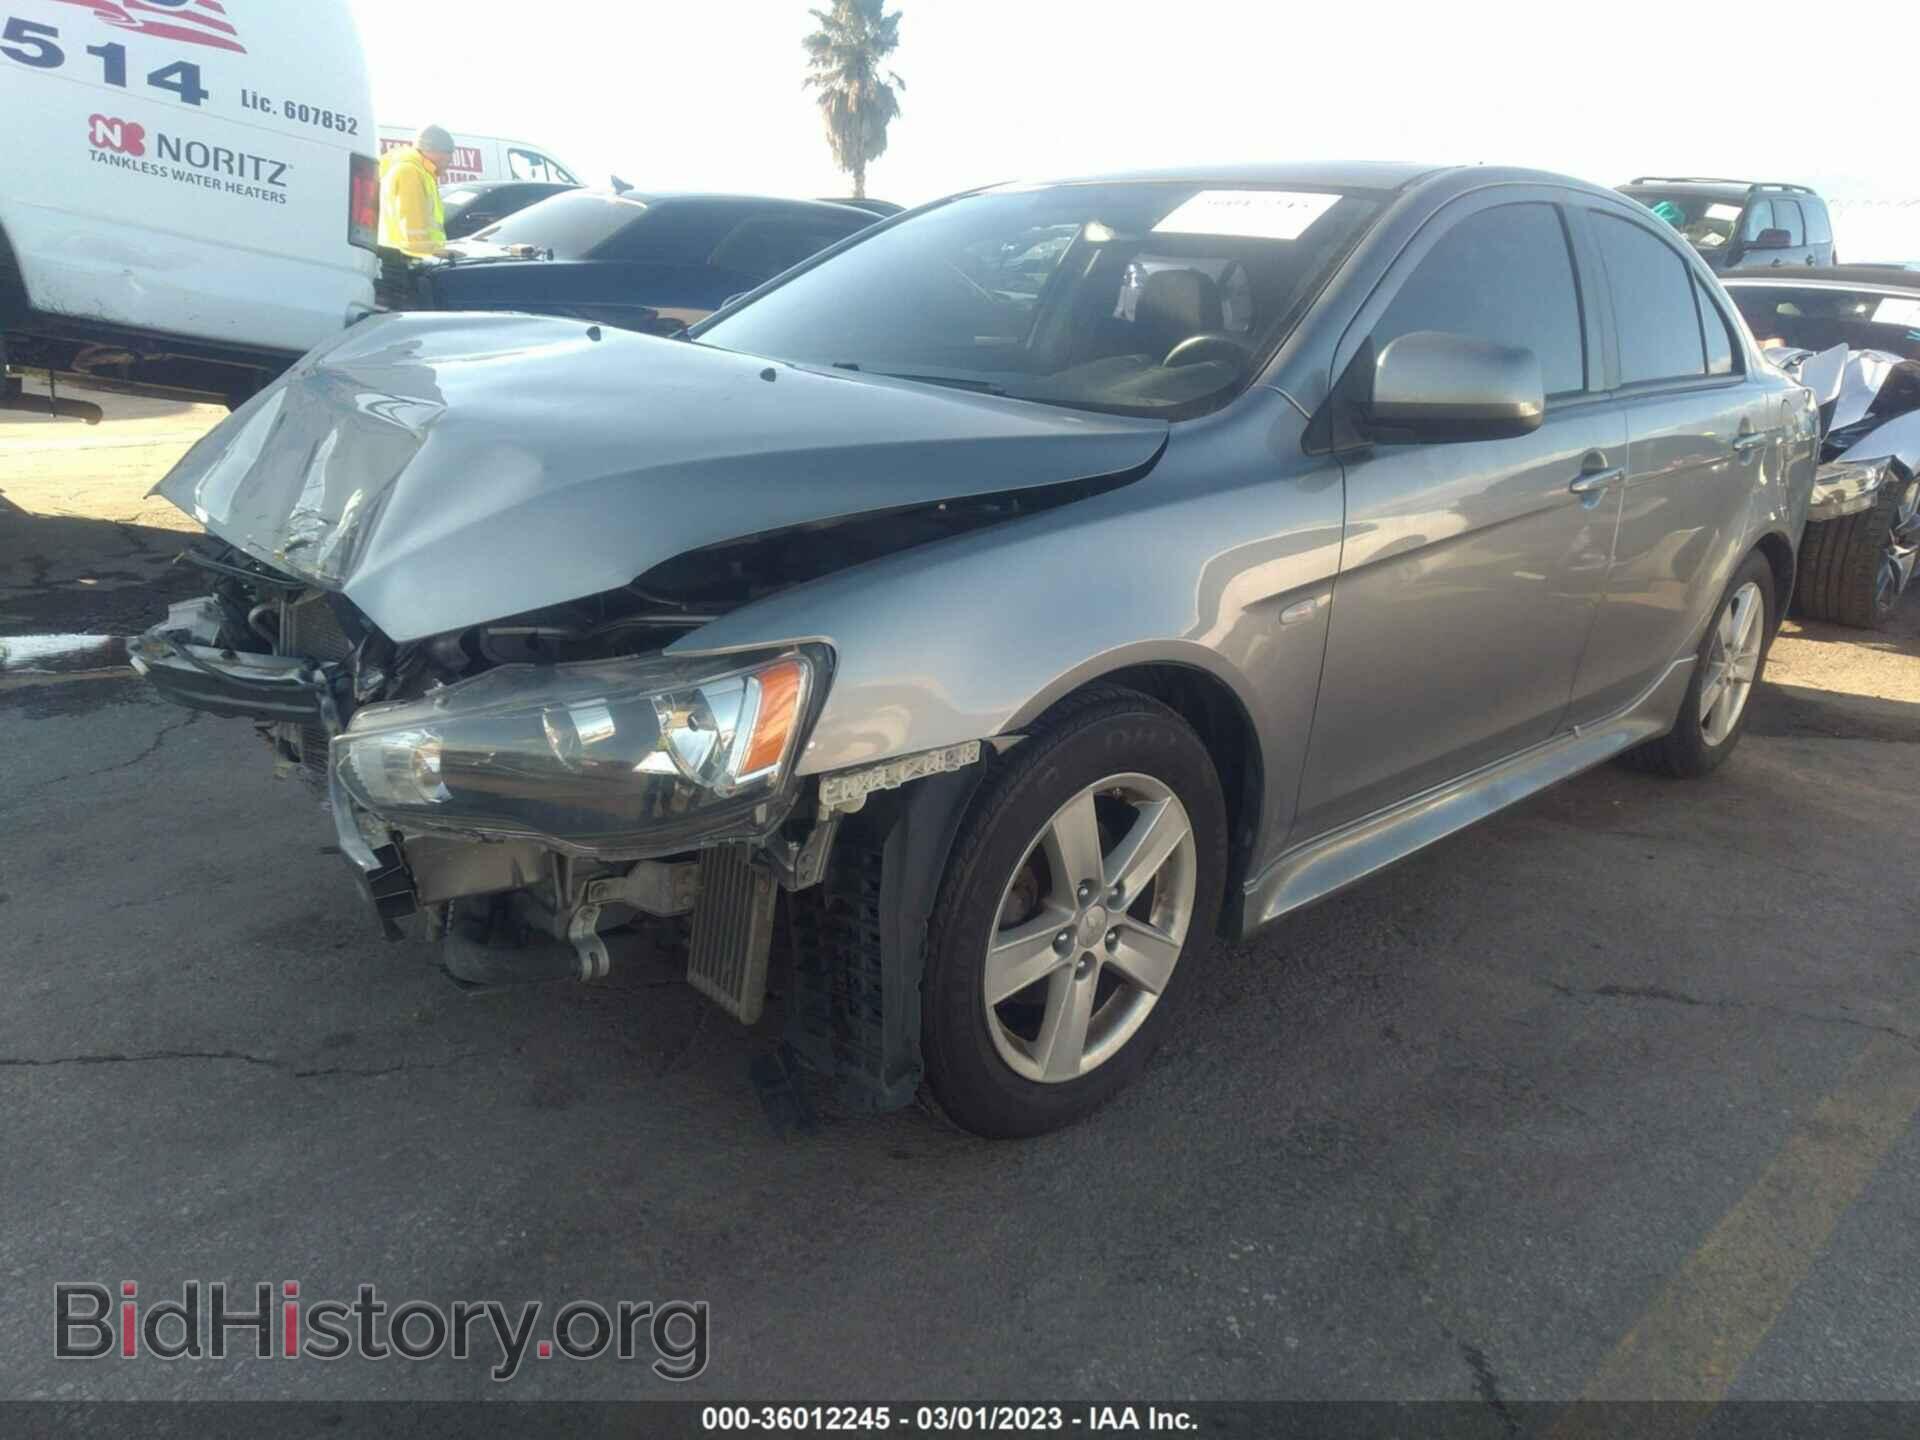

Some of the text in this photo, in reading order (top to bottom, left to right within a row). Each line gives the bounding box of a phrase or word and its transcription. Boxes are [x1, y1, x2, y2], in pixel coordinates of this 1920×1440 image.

[241, 89, 359, 136] Lic. 607852
[89, 149, 287, 205] TANKLESS WATER HEATERS
[157, 133, 287, 187] NORITZ
